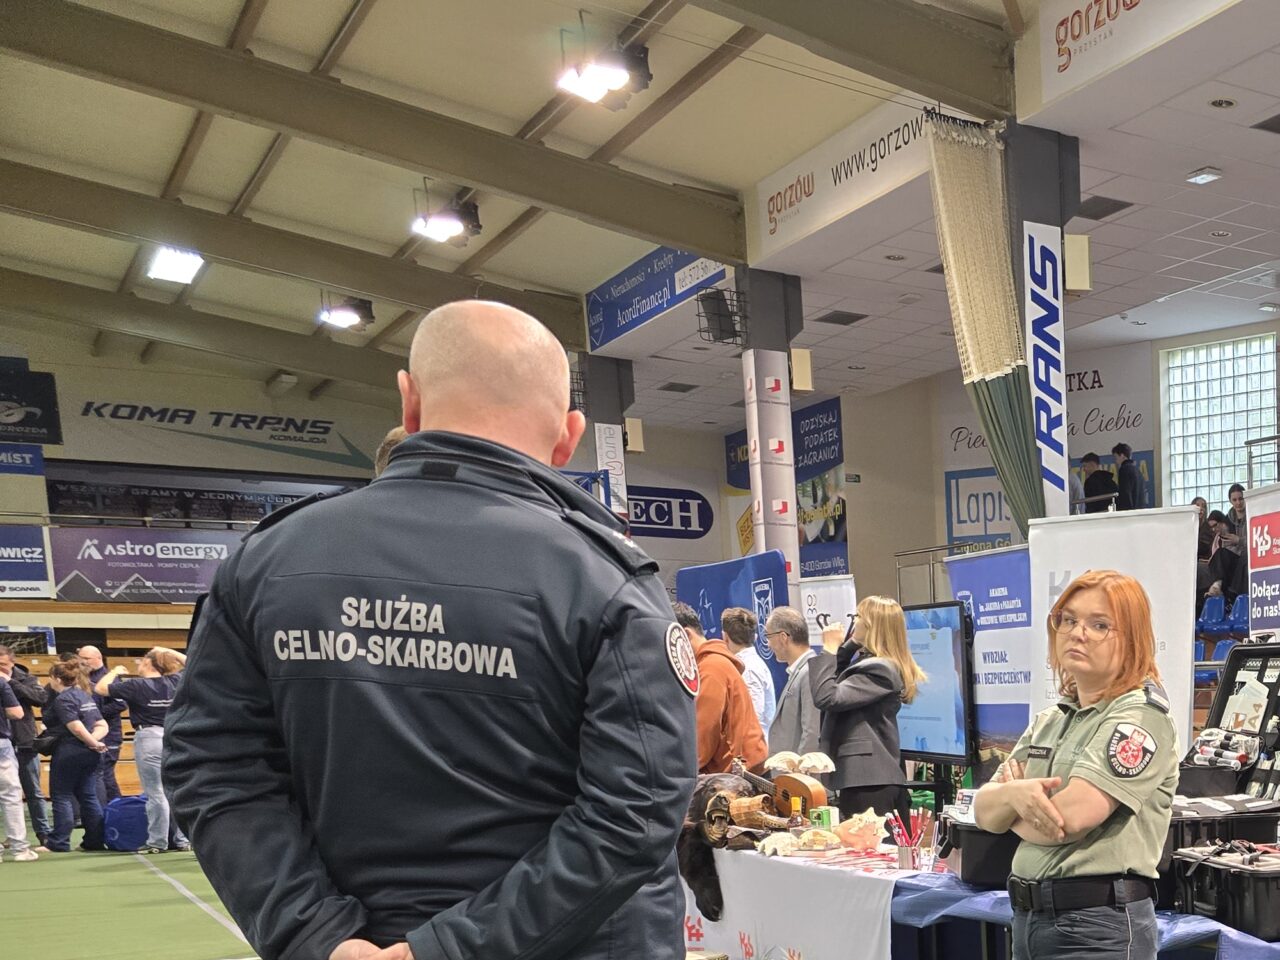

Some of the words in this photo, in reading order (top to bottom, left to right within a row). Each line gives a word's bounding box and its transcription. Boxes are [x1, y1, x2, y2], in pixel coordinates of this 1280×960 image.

[617, 279, 671, 327] AcordFinance.pl
[81, 401, 196, 425] KOMA
[800, 410, 837, 433] ODZYSKAJ
[1083, 404, 1143, 435] Ciebie
[804, 428, 838, 449] PODATEK
[798, 443, 840, 467] ZAGRANICY
[1252, 580, 1279, 600] Dołącz
[341, 594, 445, 634] SŁUŻBA
[1252, 603, 1261, 618] do
[1264, 600, 1280, 617] nas!
[273, 630, 518, 679] CELNO-SKARBOWA
[982, 651, 1009, 664] WYDZIAŁ
